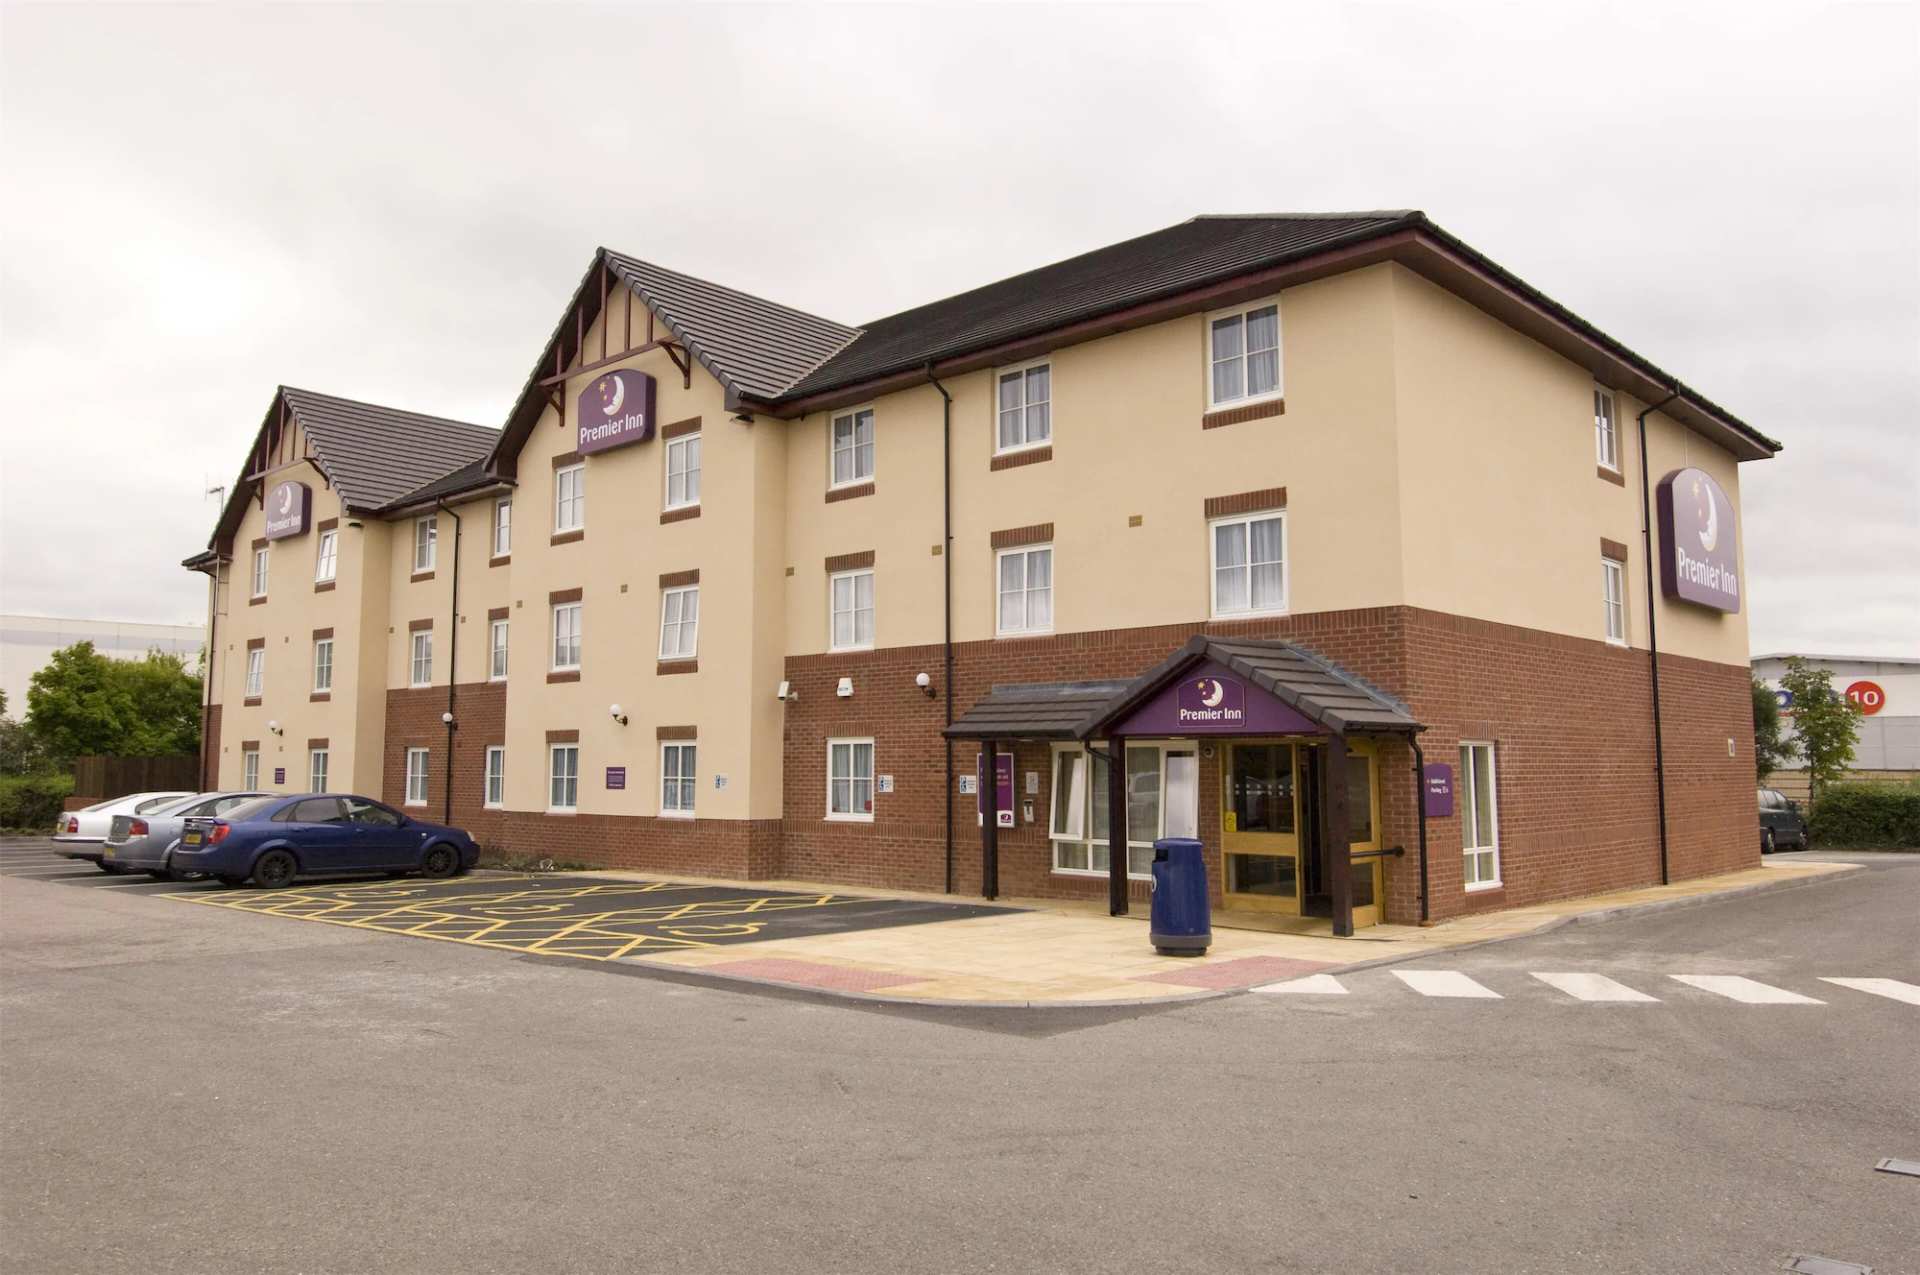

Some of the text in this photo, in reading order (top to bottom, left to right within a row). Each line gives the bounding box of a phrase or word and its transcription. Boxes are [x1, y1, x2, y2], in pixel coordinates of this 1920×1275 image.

[580, 413, 643, 445] Premier Inn
[1678, 546, 1737, 596] Premier Inn
[1850, 690, 1879, 706] 10
[1180, 707, 1242, 720] Premier Inn
